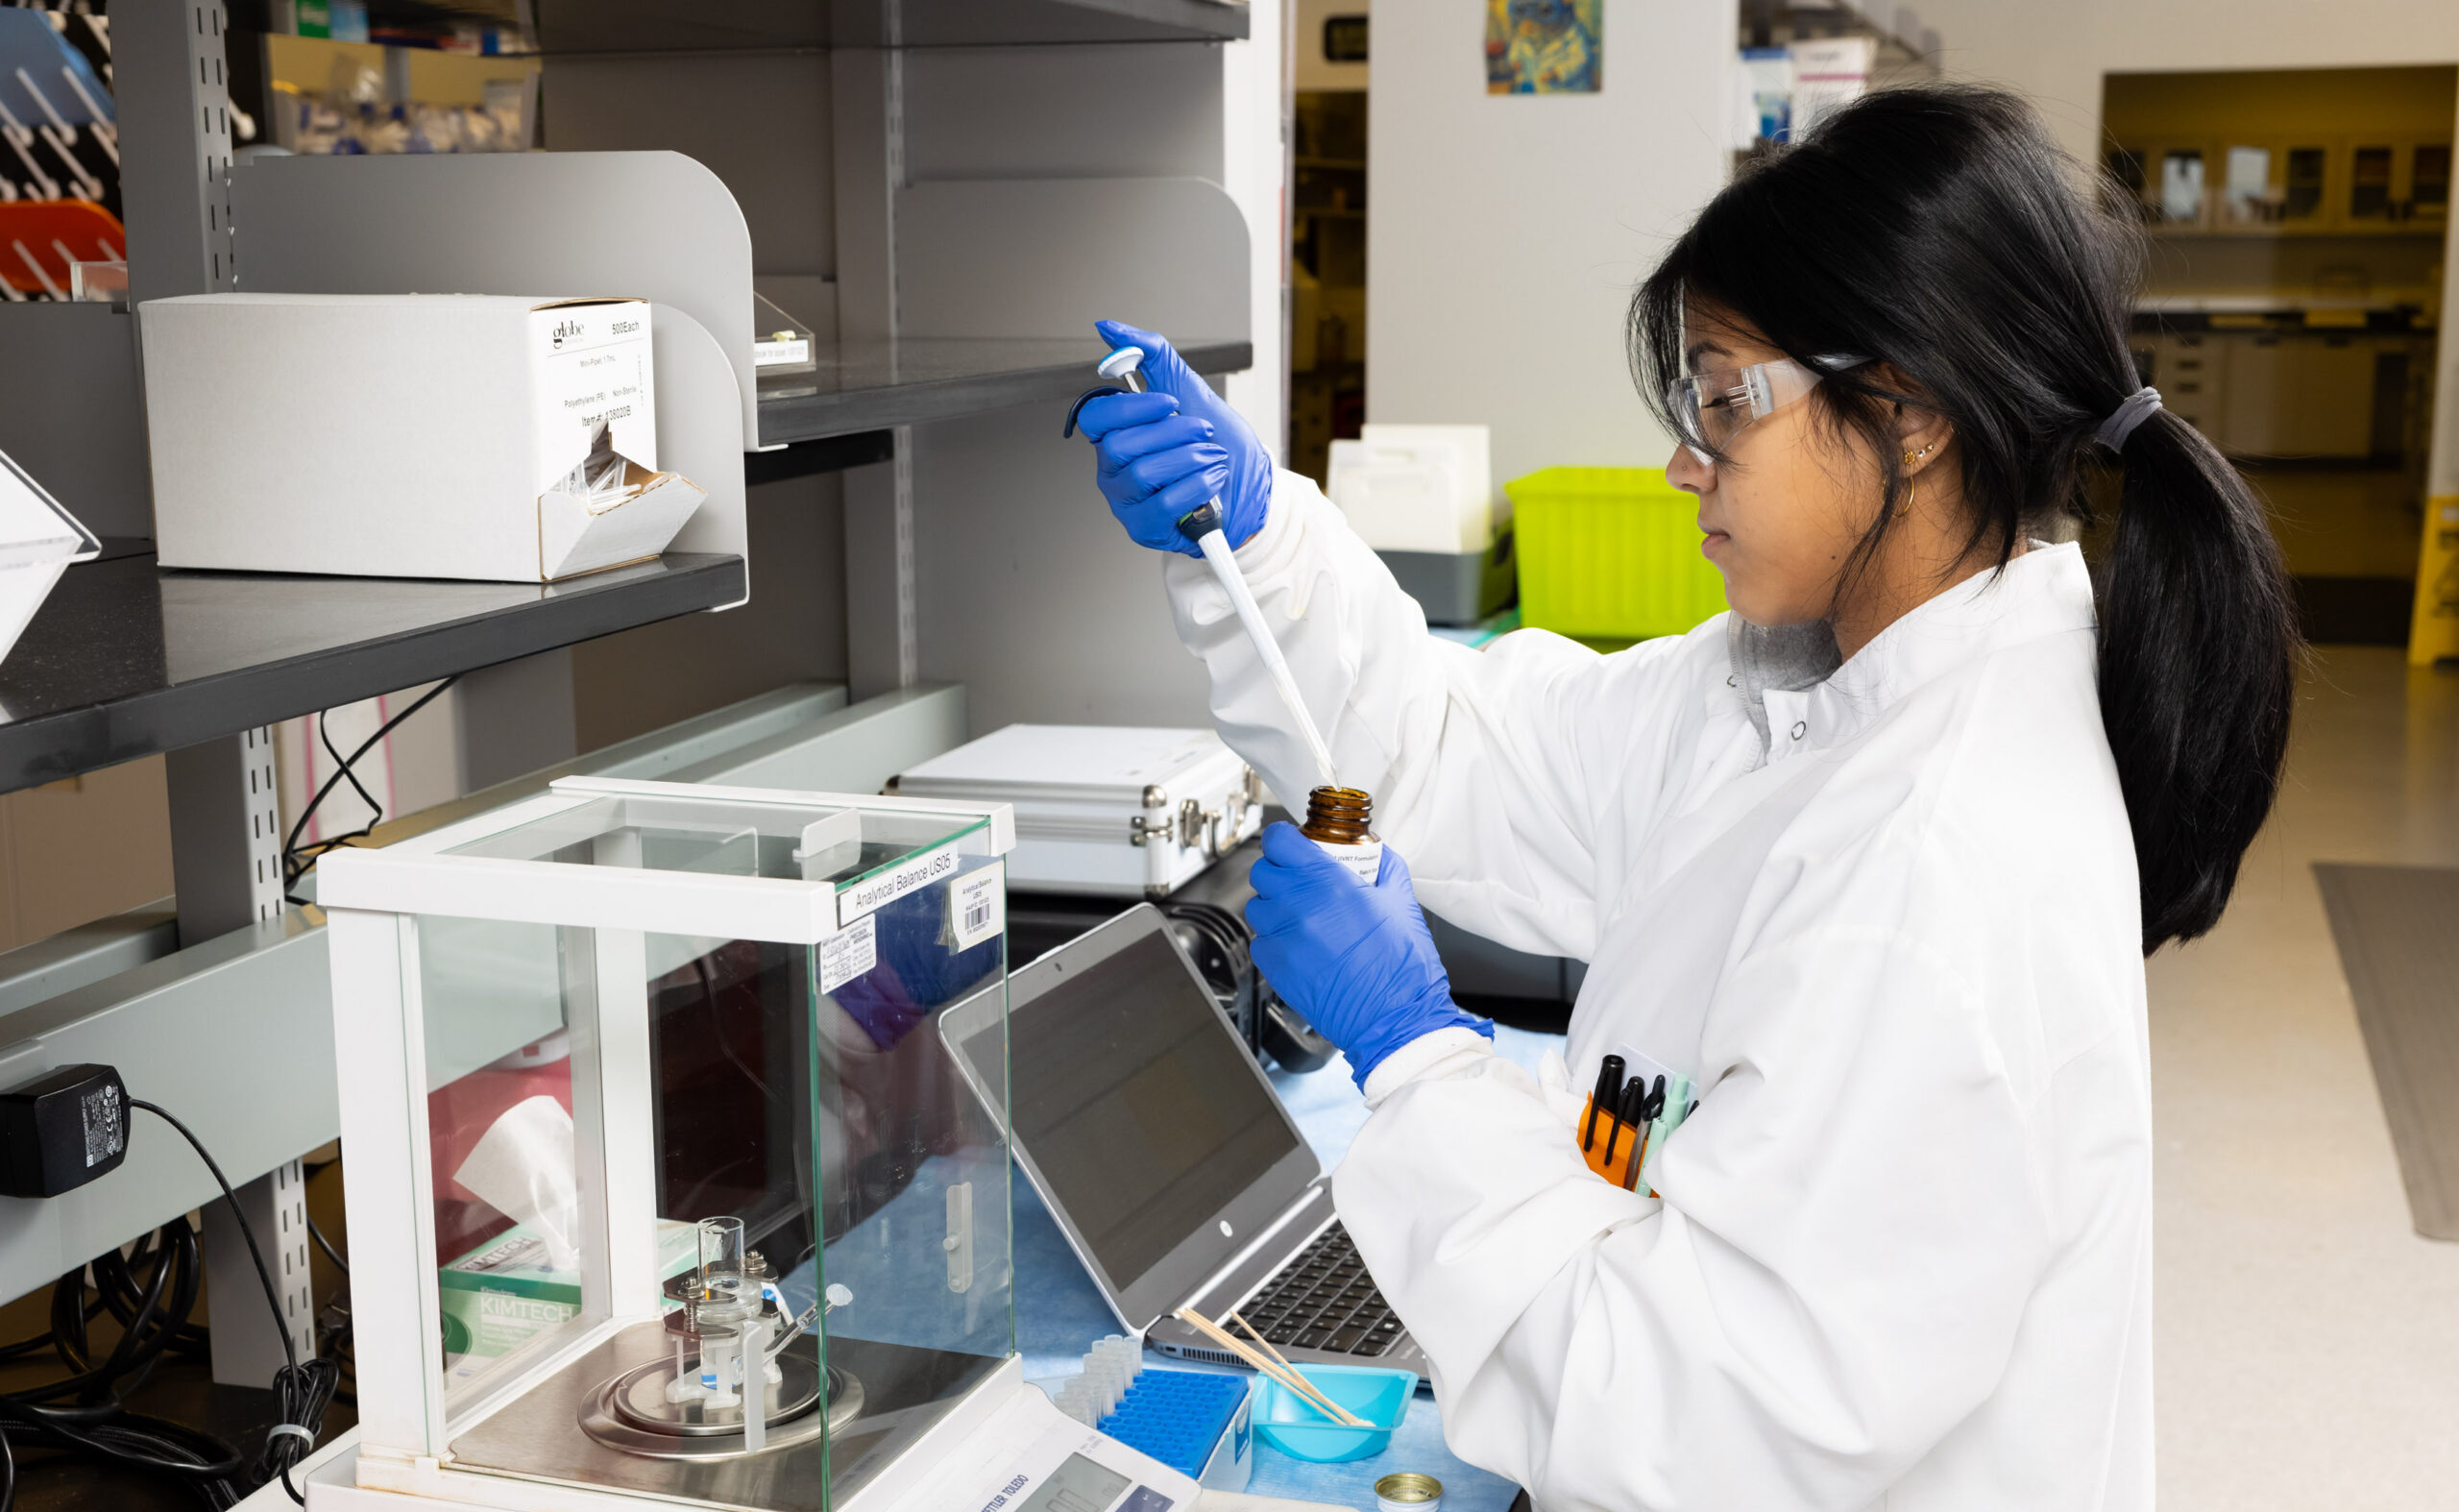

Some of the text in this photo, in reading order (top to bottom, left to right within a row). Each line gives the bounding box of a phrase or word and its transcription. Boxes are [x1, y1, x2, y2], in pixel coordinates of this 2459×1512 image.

[553, 320, 584, 349] globe
[612, 321, 640, 335] 500Each
[856, 852, 951, 910] Analytical Balance US05
[480, 1297, 574, 1324] KIMTECH
[1002, 1474, 1029, 1497] TOLEDO
